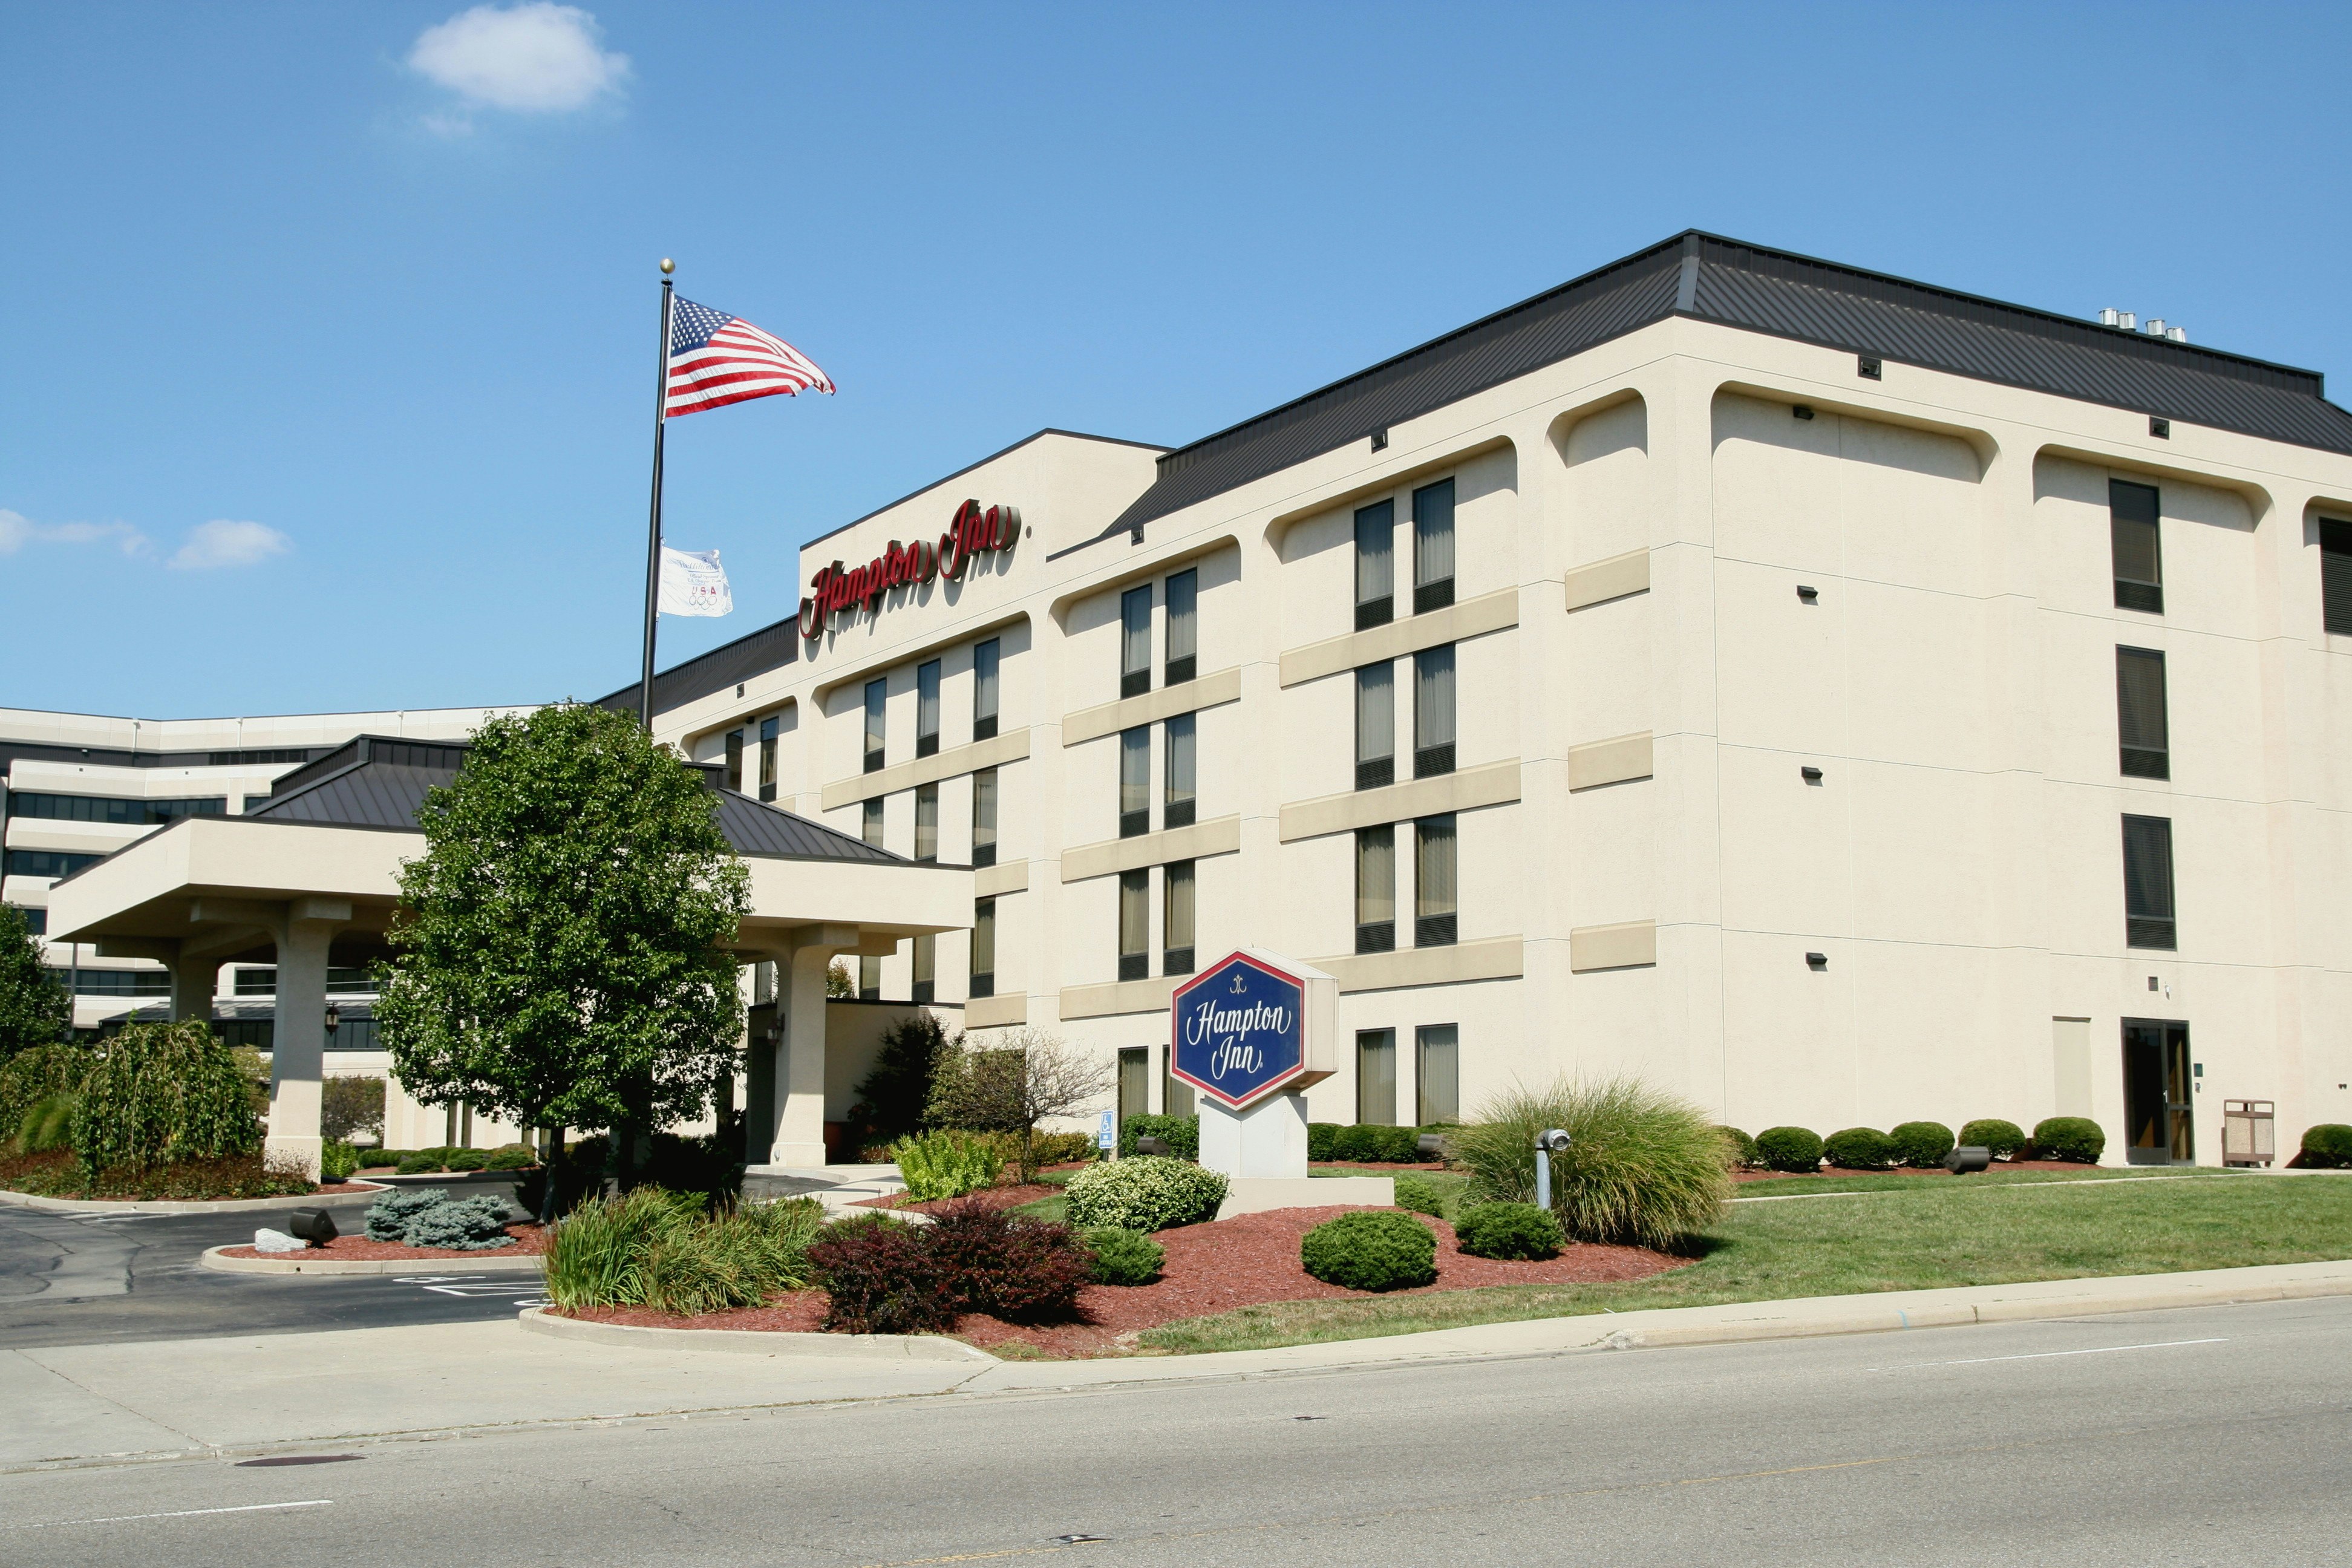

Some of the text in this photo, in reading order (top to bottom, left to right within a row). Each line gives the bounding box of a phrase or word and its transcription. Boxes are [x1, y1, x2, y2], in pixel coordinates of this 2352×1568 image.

[799, 499, 1021, 639] Hampton Inn
[1186, 999, 1291, 1045] Hampton
[1211, 1036, 1263, 1080] Inn
